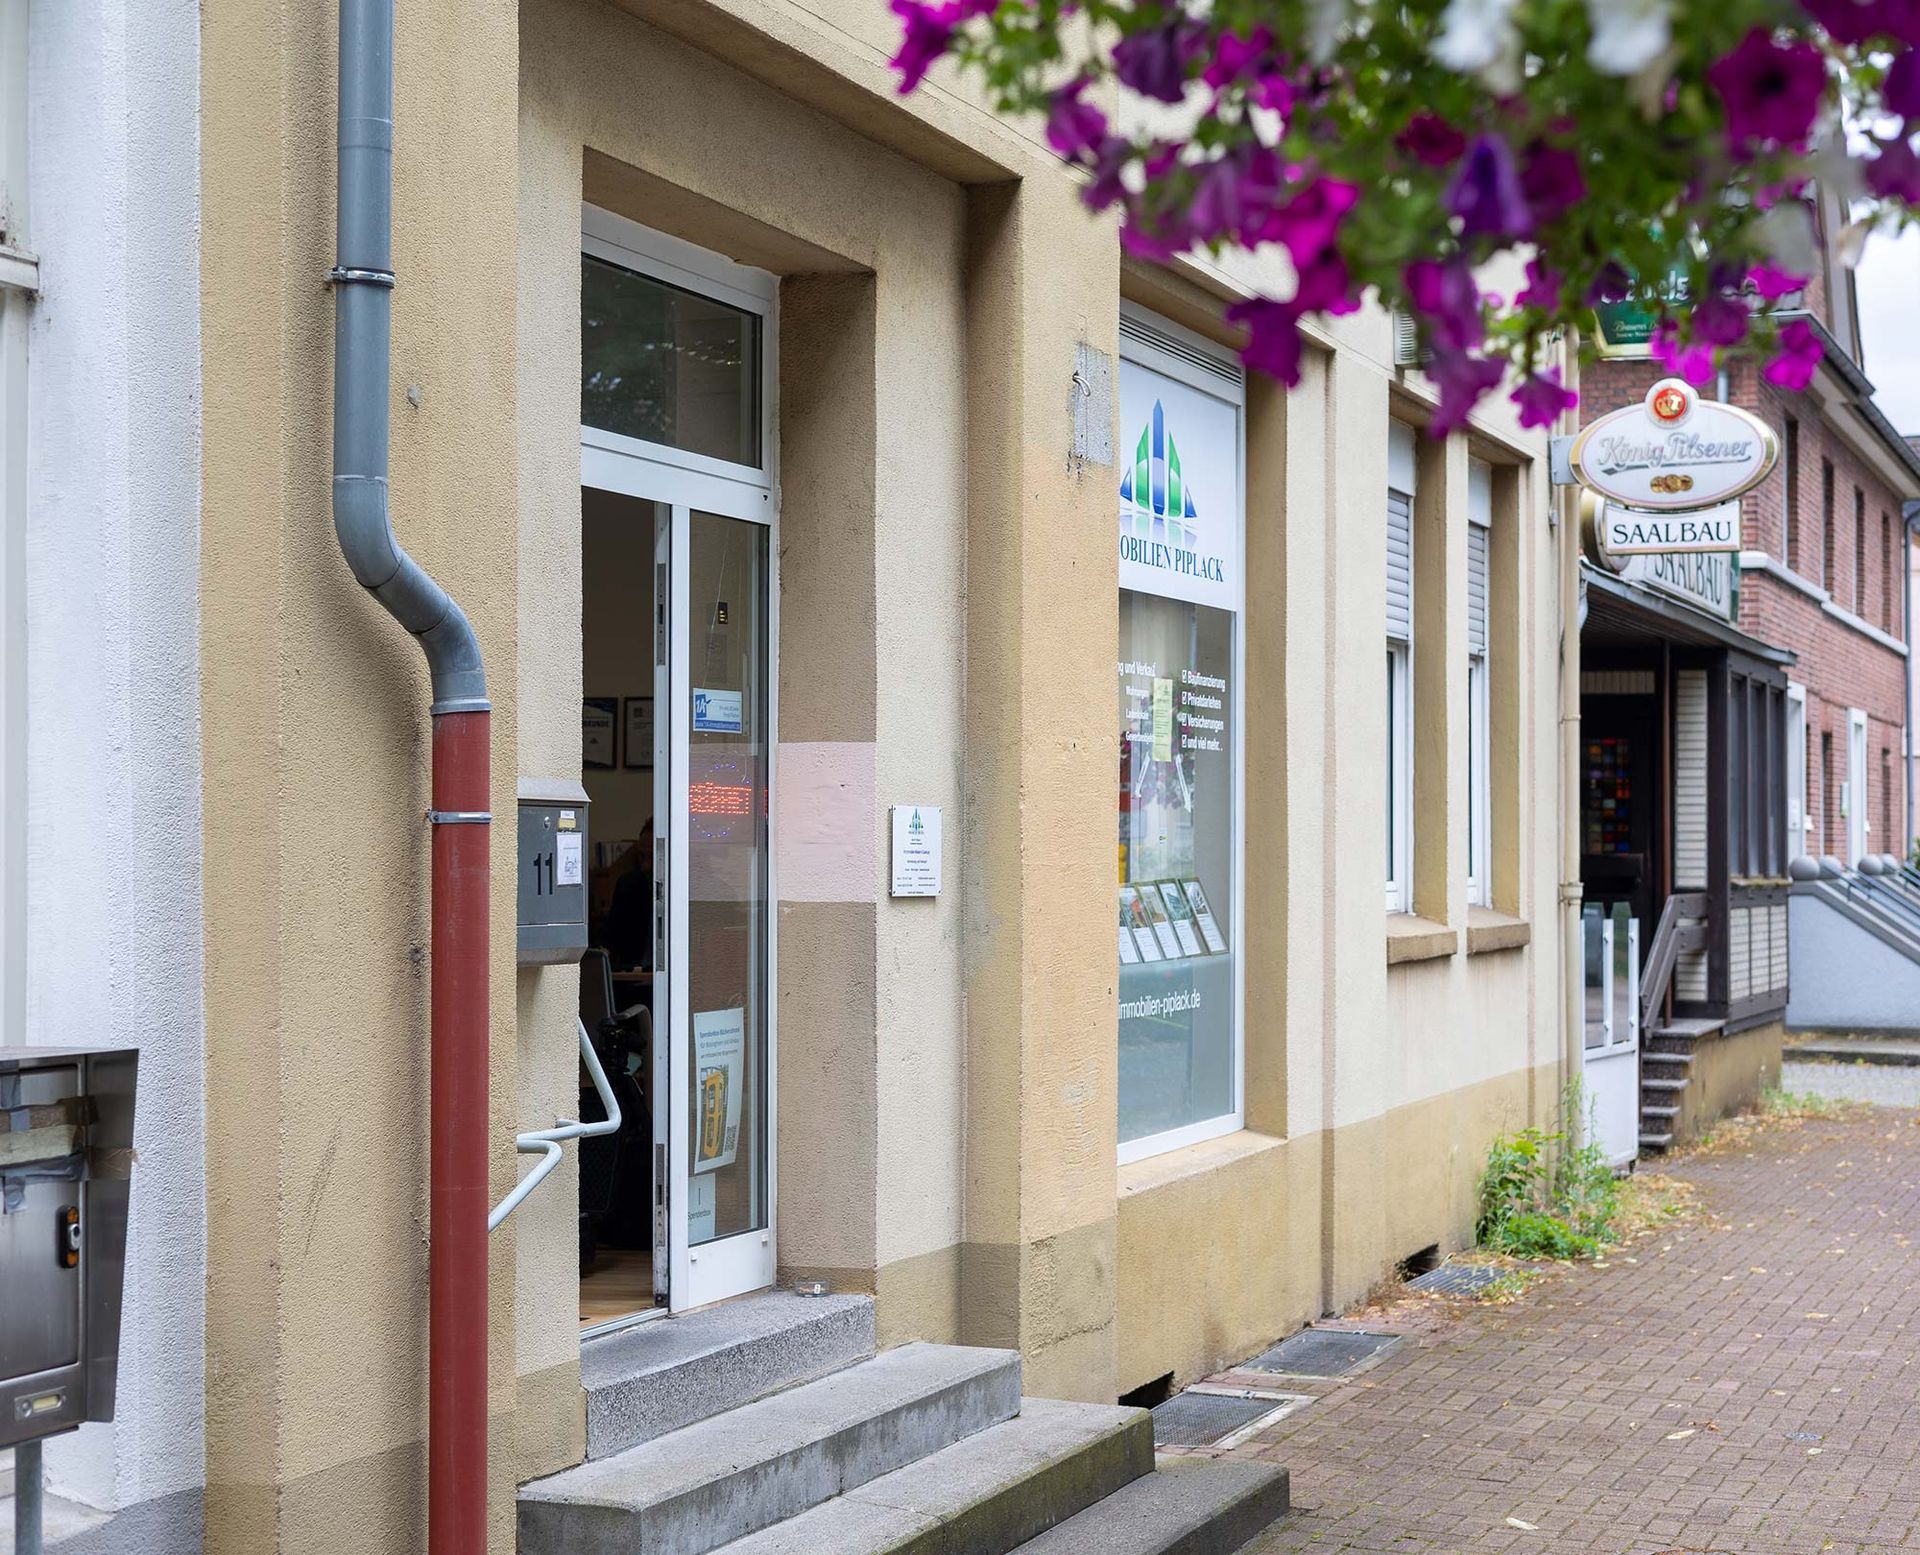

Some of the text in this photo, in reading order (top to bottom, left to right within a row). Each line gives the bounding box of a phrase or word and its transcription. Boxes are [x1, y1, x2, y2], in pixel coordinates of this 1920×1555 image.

[1599, 432, 1752, 468] König Pilsener
[1612, 521, 1731, 544] SAALBAU
[1175, 548, 1224, 582] PIPLACK
[1125, 661, 1136, 674] und
[1187, 713, 1224, 733] Versicherungen
[1187, 736, 1198, 749] und
[1198, 737, 1207, 750] viel
[533, 853, 553, 896] 11
